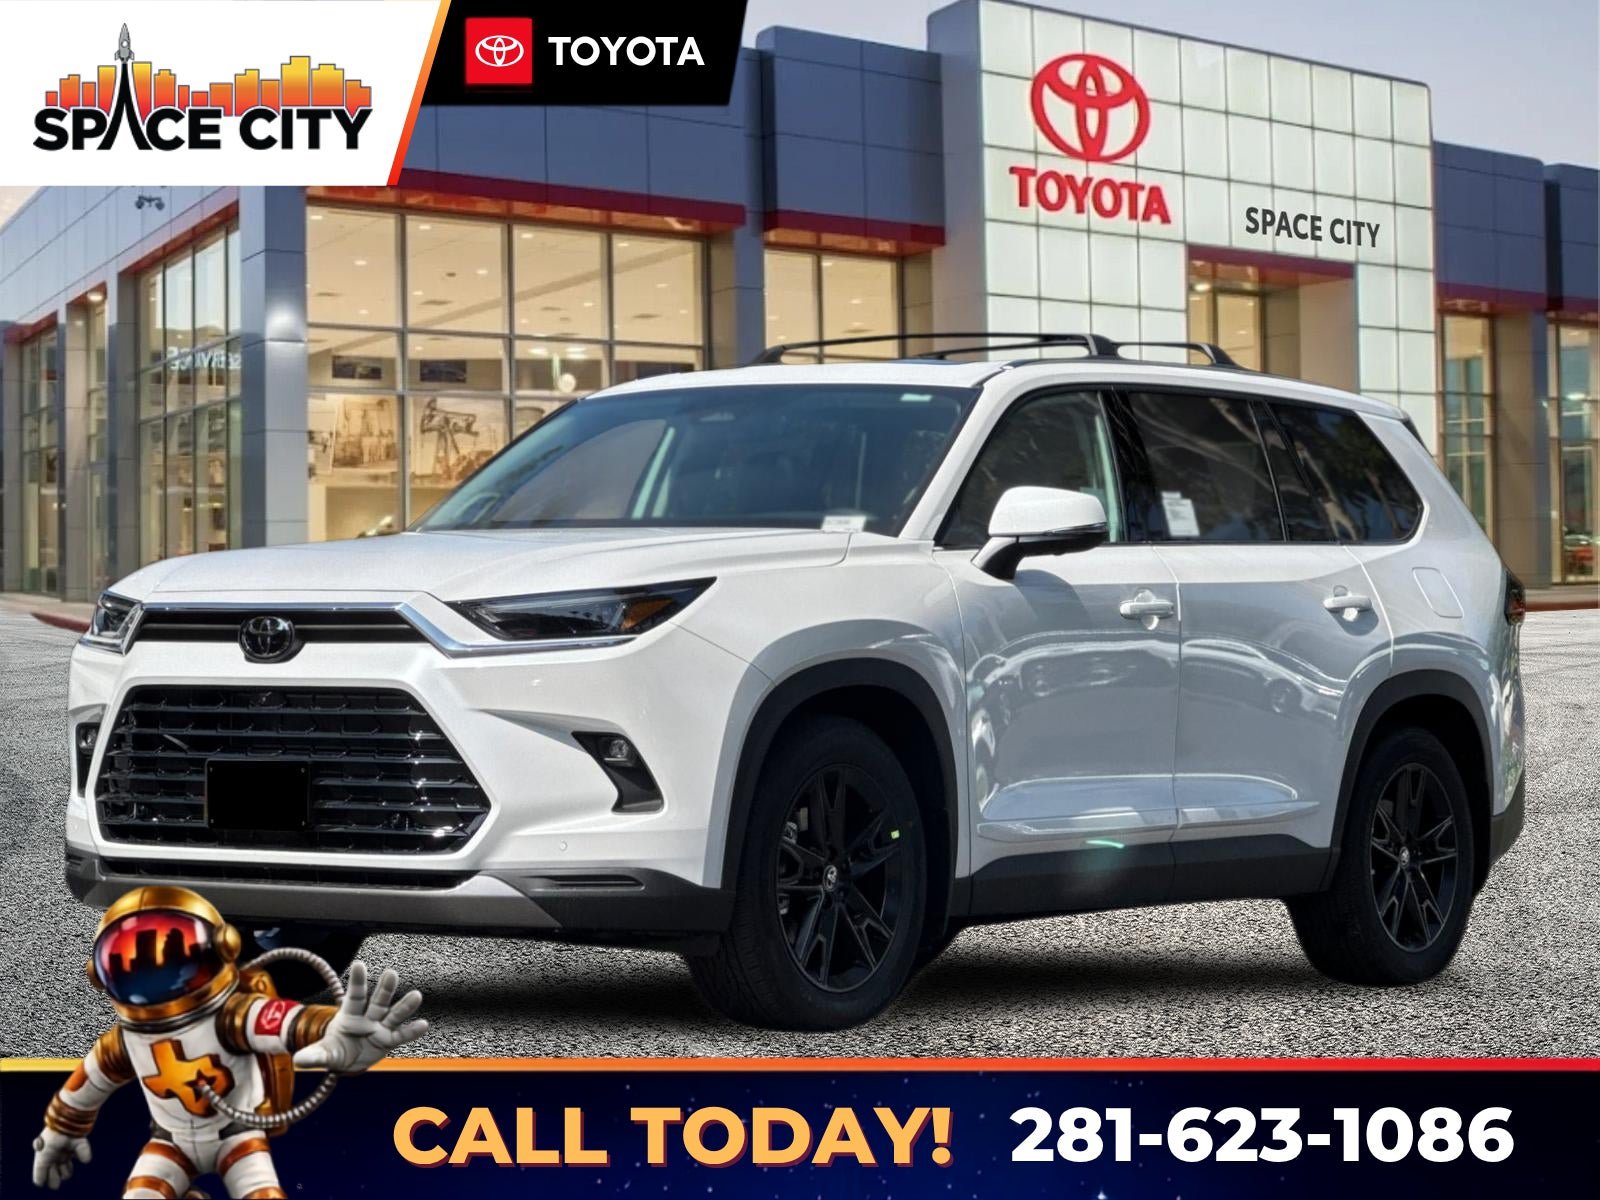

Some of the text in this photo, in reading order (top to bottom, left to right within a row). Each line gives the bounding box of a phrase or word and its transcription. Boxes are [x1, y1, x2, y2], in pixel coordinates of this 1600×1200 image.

[1009, 165, 1171, 225] TOYOTA
[1245, 206, 1381, 248] SPACE CITY
